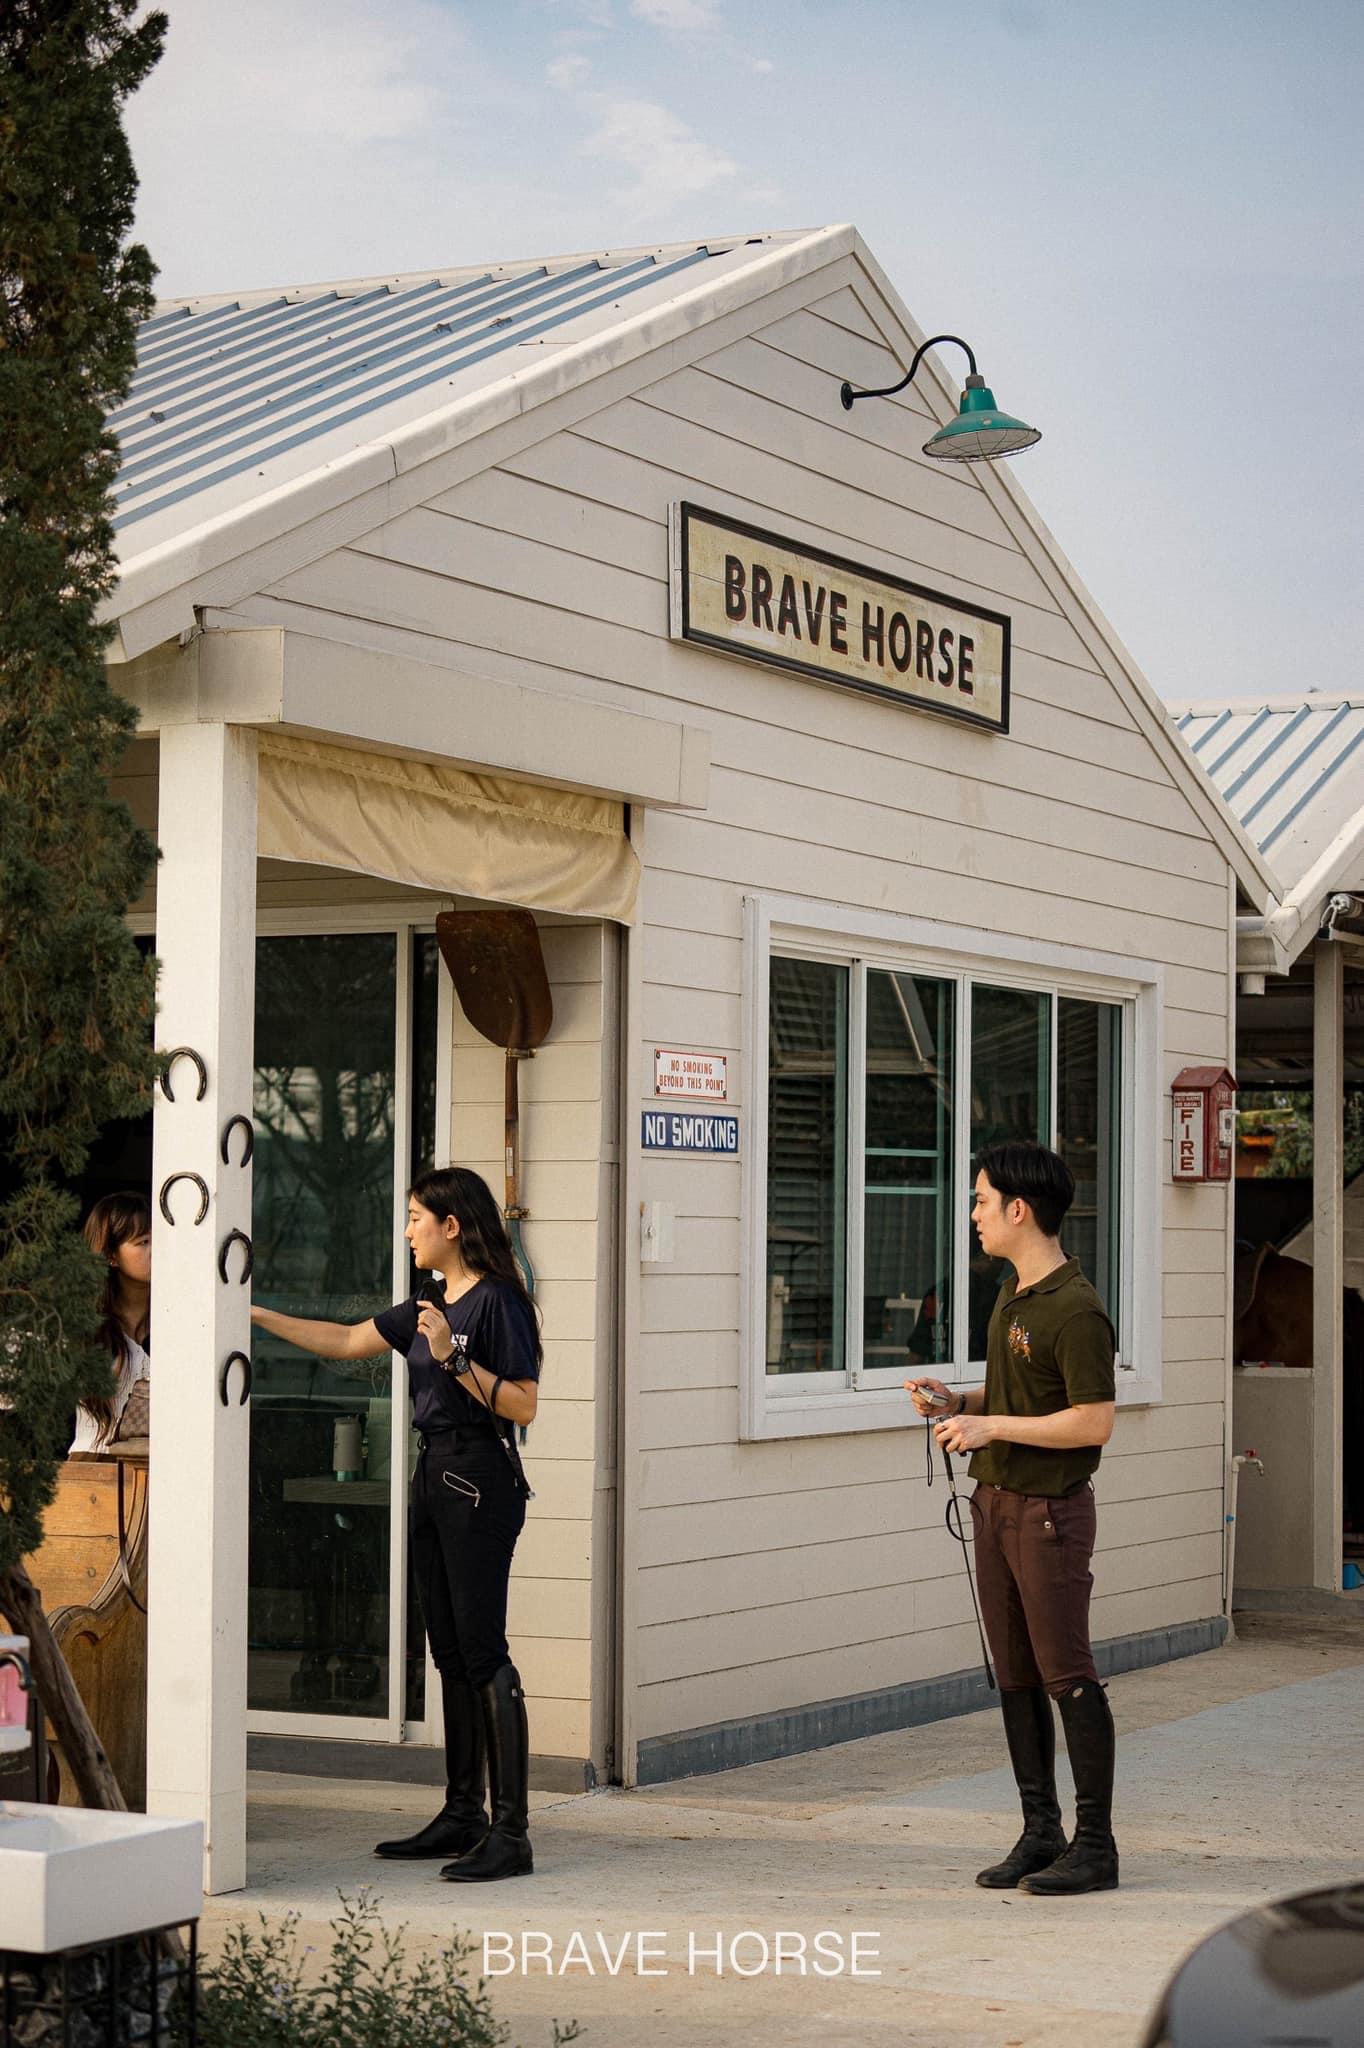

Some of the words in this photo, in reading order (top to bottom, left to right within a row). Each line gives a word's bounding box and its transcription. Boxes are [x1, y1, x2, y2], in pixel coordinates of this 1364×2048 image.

[724, 554, 848, 655] BRAVE
[862, 601, 974, 695] HORSE
[659, 1074, 684, 1088] BEYOND
[687, 1077, 702, 1089] THIS
[705, 1079, 724, 1091] POINT
[671, 1060, 680, 1072] NO
[683, 1061, 713, 1075] SMOKING
[645, 1115, 667, 1145] NO
[672, 1117, 736, 1149] SMOKING
[1180, 1109, 1195, 1171] FIRE
